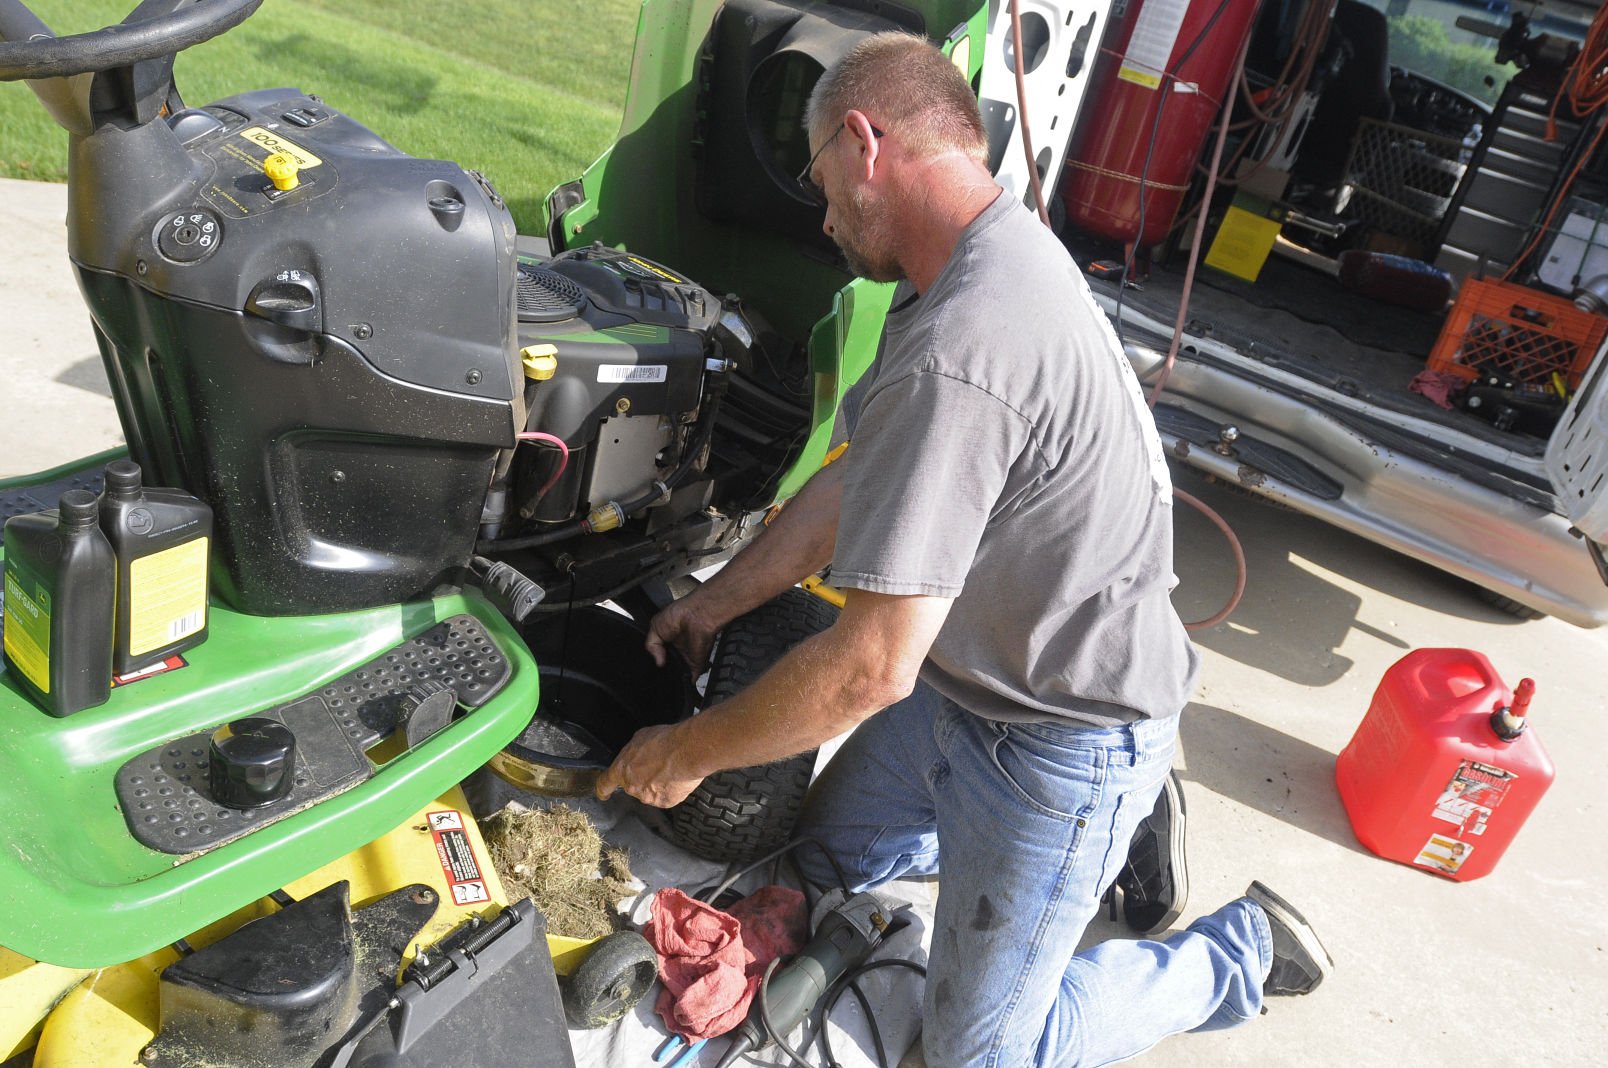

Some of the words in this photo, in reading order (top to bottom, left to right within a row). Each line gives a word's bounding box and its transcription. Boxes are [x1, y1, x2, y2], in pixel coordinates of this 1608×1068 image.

[250, 132, 278, 146] 100
[8, 579, 39, 618] TURF-GARD
[436, 842, 450, 867] DANGER
